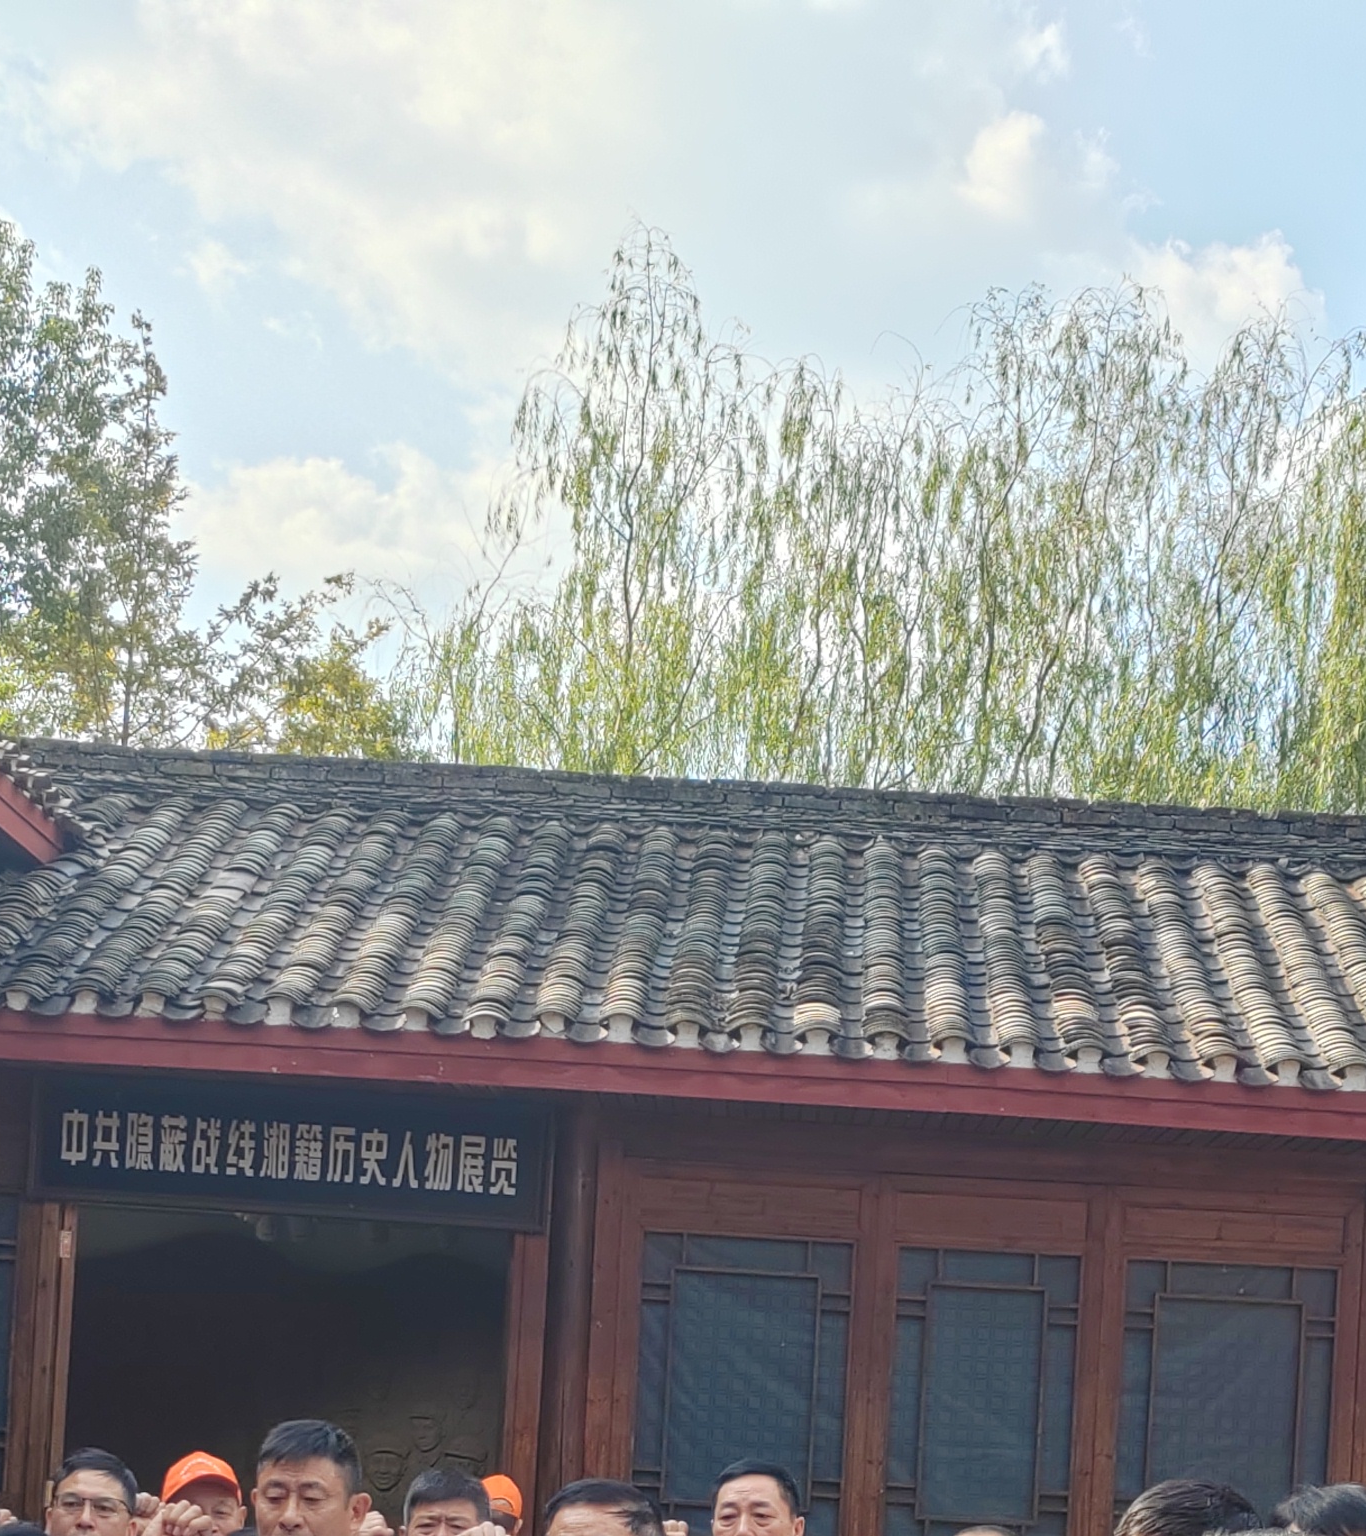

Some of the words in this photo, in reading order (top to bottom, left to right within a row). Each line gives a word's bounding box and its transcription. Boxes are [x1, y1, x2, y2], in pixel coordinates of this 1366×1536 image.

[60, 1108, 519, 1197] 中共隐蔽战线湘籍历史人物展览
